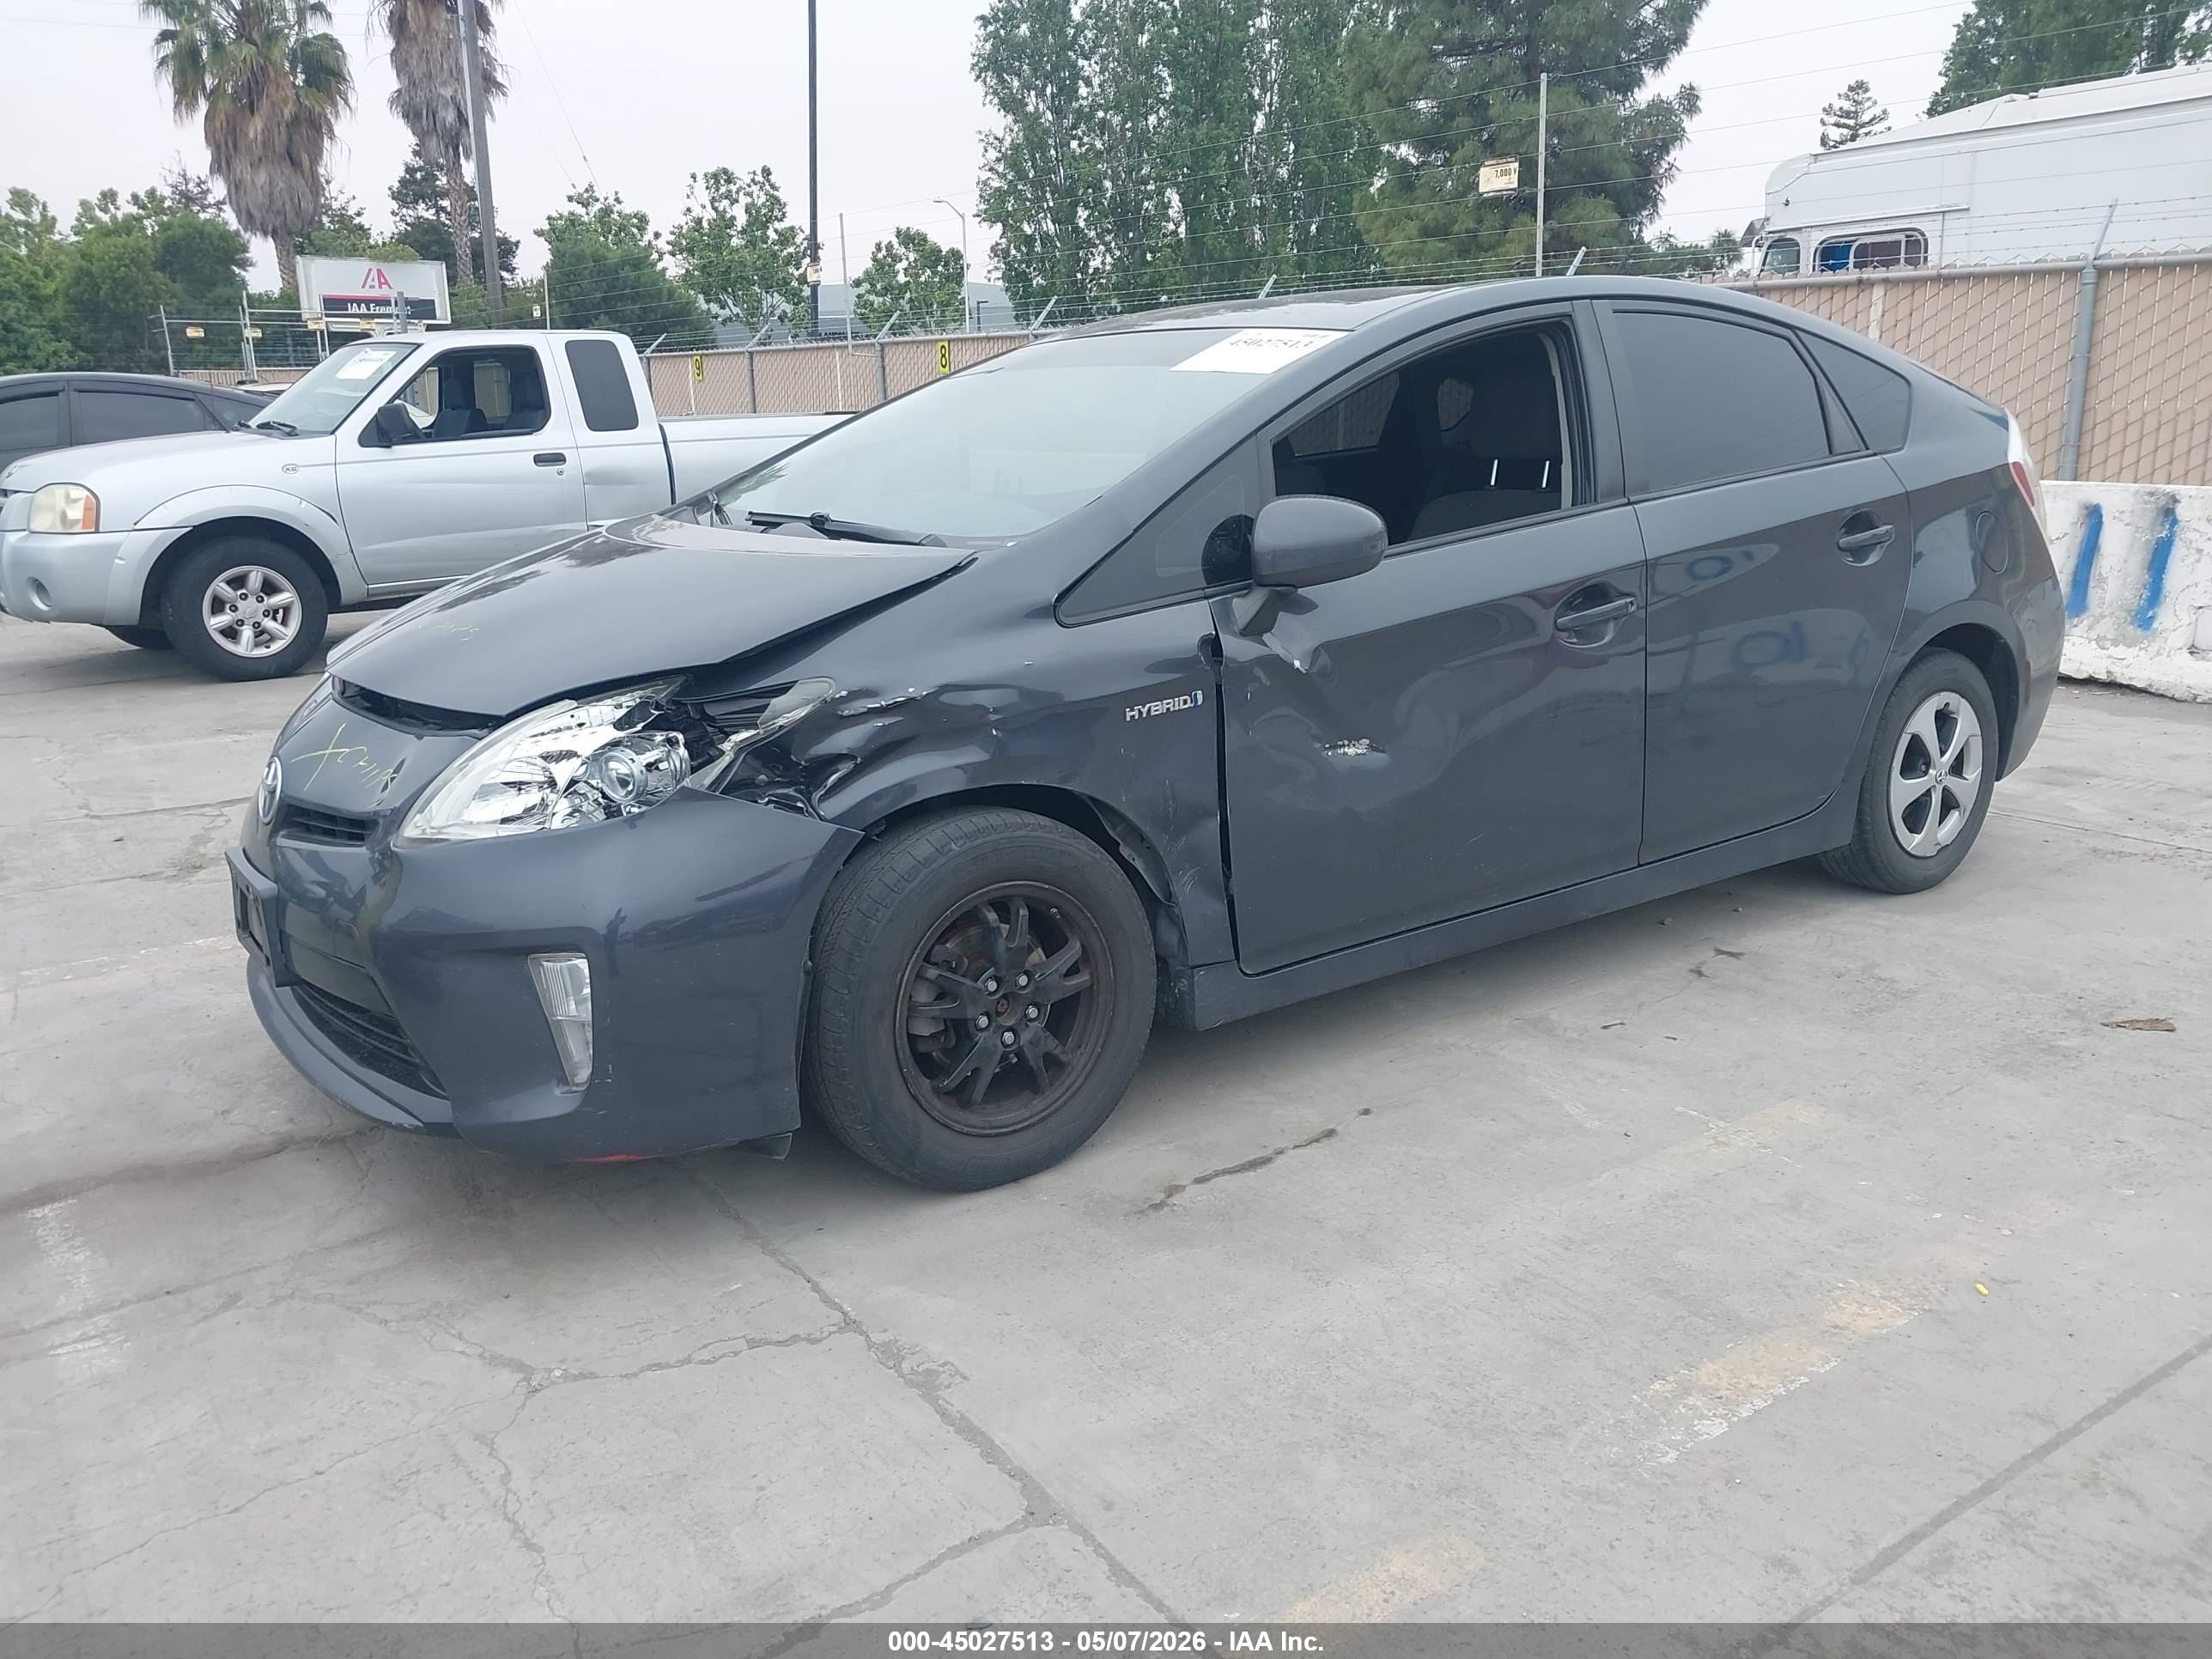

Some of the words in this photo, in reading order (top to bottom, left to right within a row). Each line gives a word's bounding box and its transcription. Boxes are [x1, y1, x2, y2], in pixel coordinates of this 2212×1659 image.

[1494, 168, 1512, 179] 7,000
[347, 302, 368, 313] IAA
[939, 344, 948, 369] 8
[695, 358, 702, 377] 9
[1125, 696, 1192, 721] HYBRID
